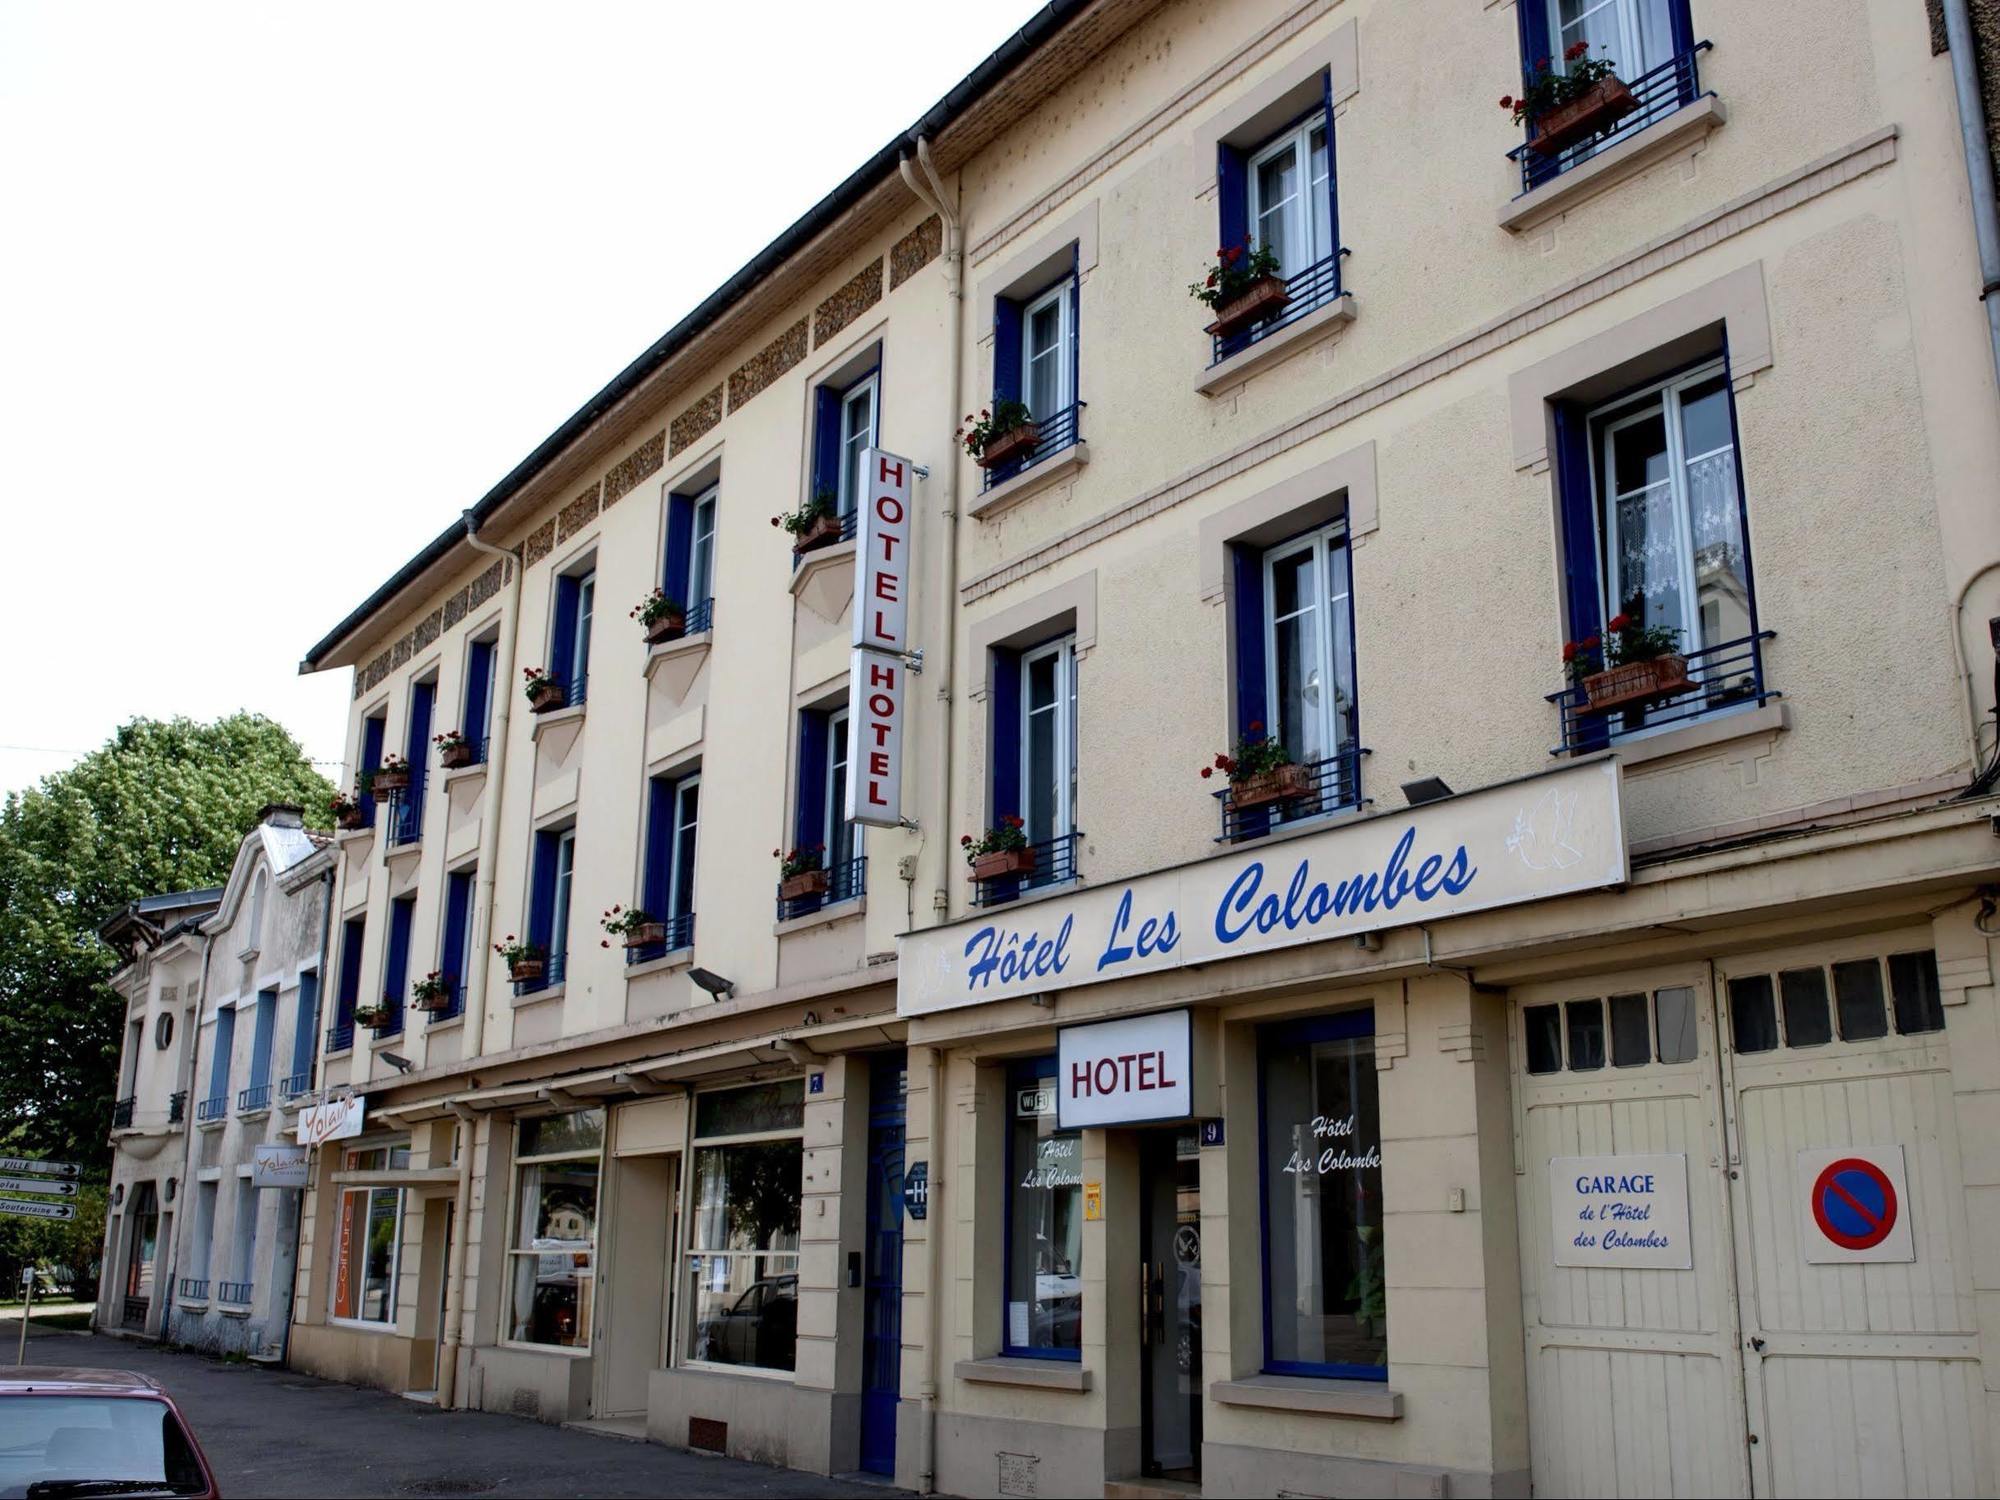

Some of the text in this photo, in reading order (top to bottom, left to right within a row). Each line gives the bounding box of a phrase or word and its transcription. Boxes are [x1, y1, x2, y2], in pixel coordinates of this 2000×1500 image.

[875, 457, 904, 642] HOTEL
[868, 663, 896, 807] HOTEL
[965, 826, 1478, 990] Hôtel Les Colombes
[1072, 1051, 1177, 1099] HOTEL
[1207, 1122, 1217, 1142] 9
[1311, 1114, 1354, 1138] Hôtel
[1042, 1139, 1074, 1159] Hôtel
[1283, 1145, 1382, 1174] Les Colombe
[4, 1160, 31, 1170] VILLE
[1021, 1169, 1042, 1188] Les
[1576, 1175, 1655, 1194] GARAGE
[1579, 1202, 1651, 1221] de l'Hôtel
[1573, 1229, 1670, 1250] des Colombes
